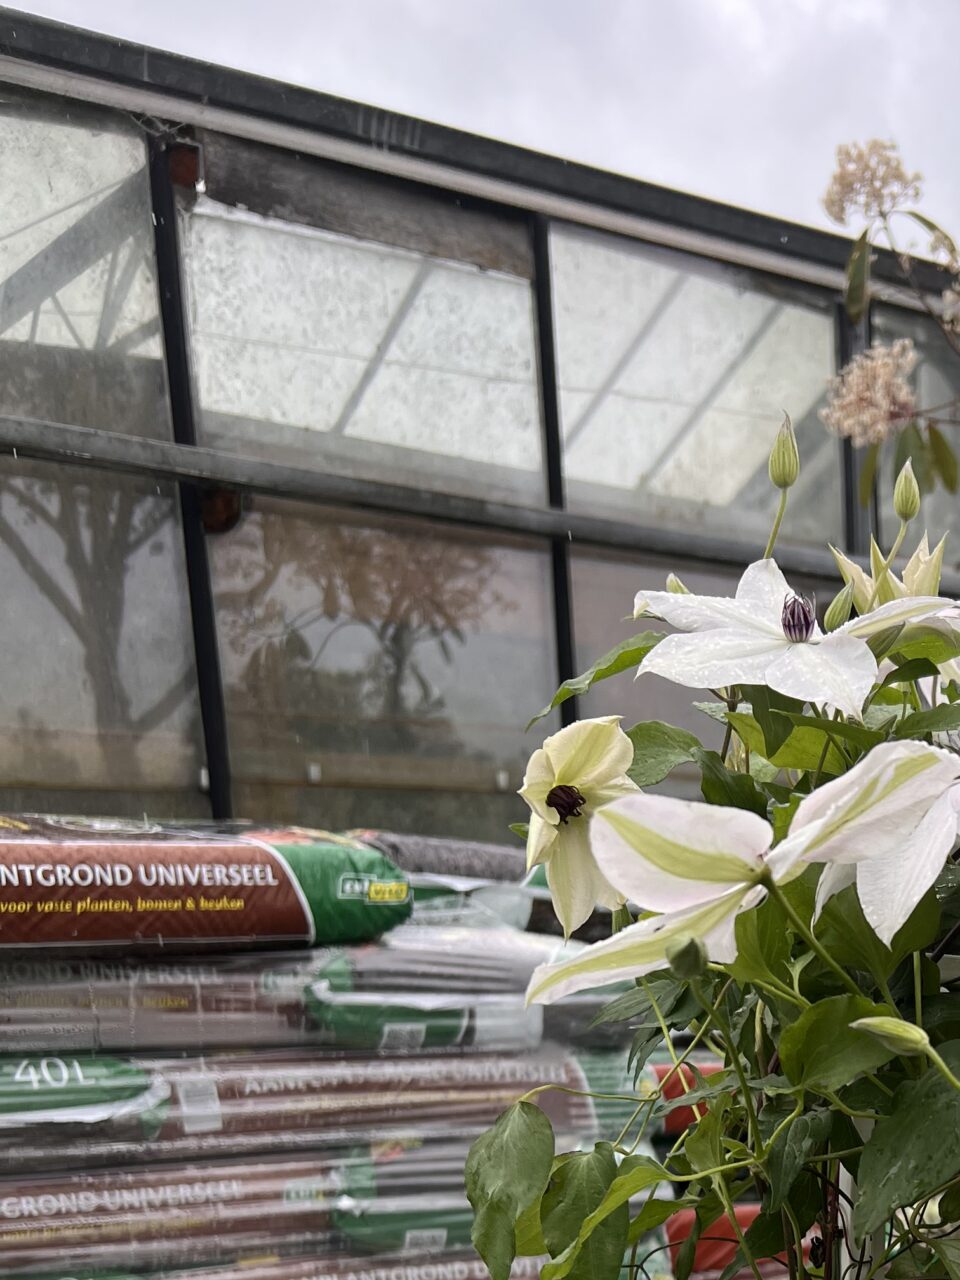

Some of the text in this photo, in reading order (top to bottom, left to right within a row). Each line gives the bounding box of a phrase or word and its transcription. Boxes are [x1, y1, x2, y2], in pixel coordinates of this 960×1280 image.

[0, 864, 279, 887] NTGROND UNIVERSEEL
[0, 901, 32, 913] voor
[37, 900, 73, 913] vaste
[77, 897, 133, 915] planten,
[186, 897, 196, 911] &
[15, 1057, 96, 1089] 40L
